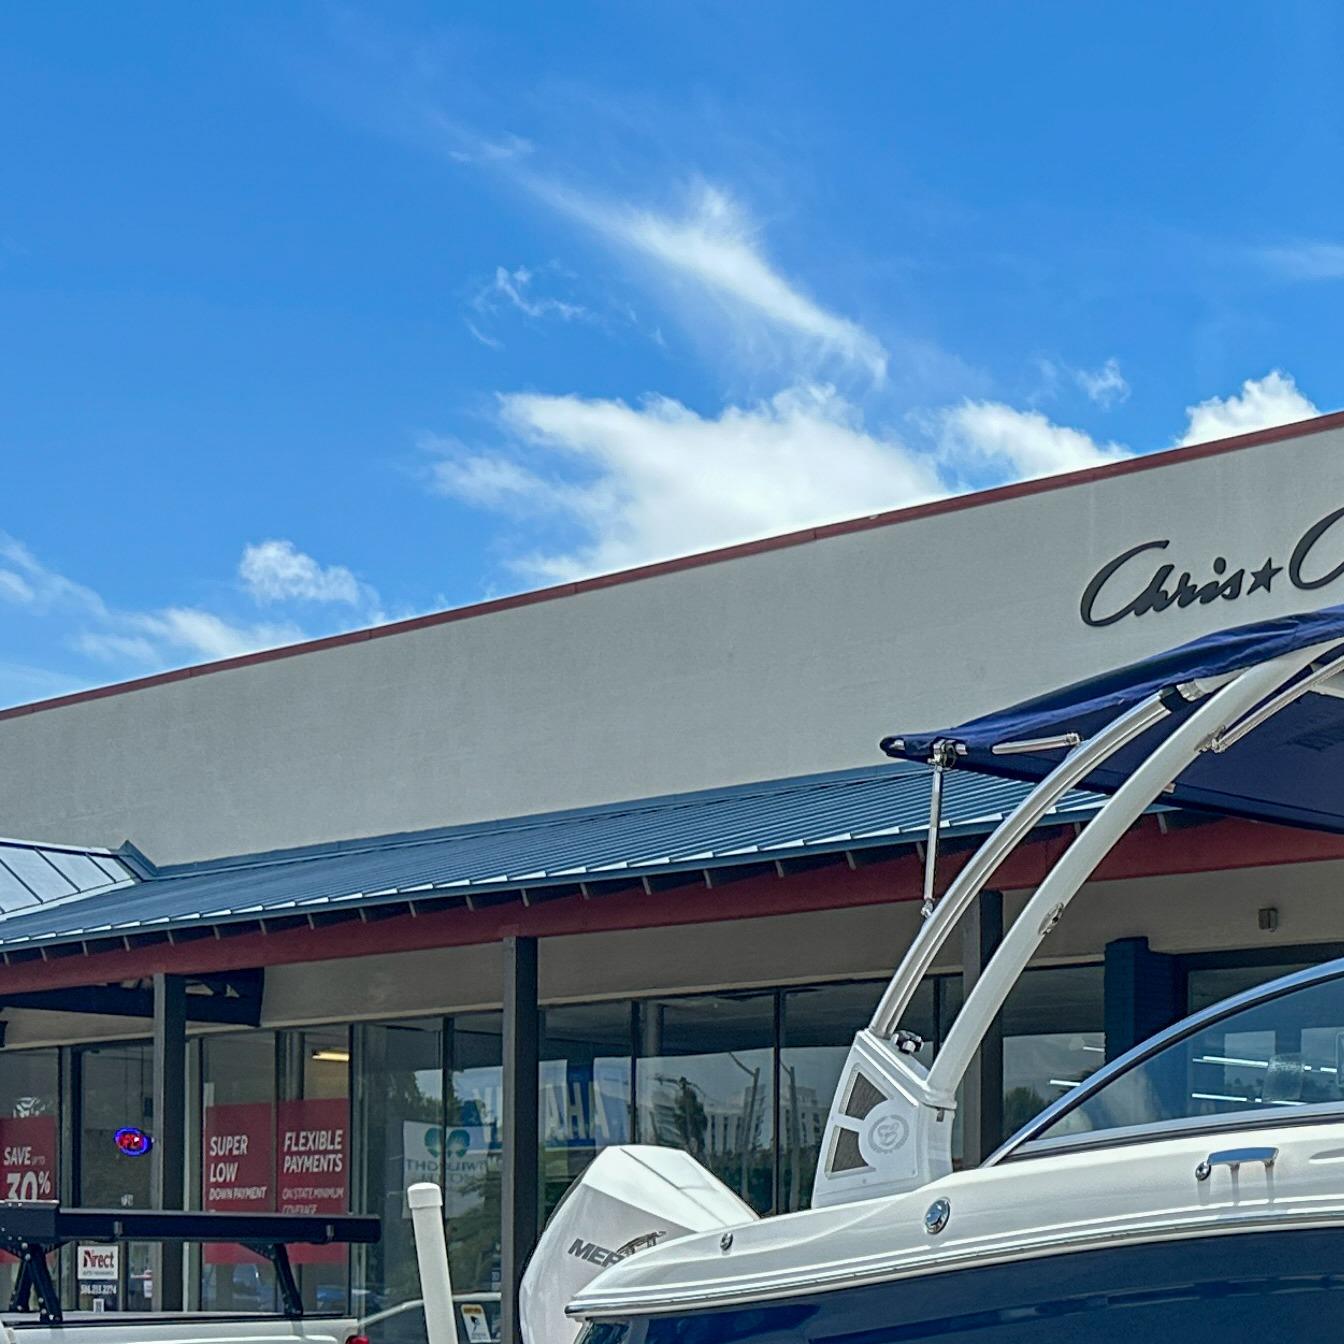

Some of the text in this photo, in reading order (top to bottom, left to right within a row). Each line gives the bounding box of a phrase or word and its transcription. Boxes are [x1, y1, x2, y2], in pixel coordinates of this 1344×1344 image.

[209, 1135, 248, 1156] SUPER
[284, 1130, 343, 1152] FLEXIBLE
[4, 1146, 32, 1166] SAVE
[283, 1154, 343, 1174] PAYMENTS
[209, 1162, 239, 1182] LOW
[209, 1186, 267, 1200] DOWN PAYMENT
[568, 1238, 625, 1267] MER
